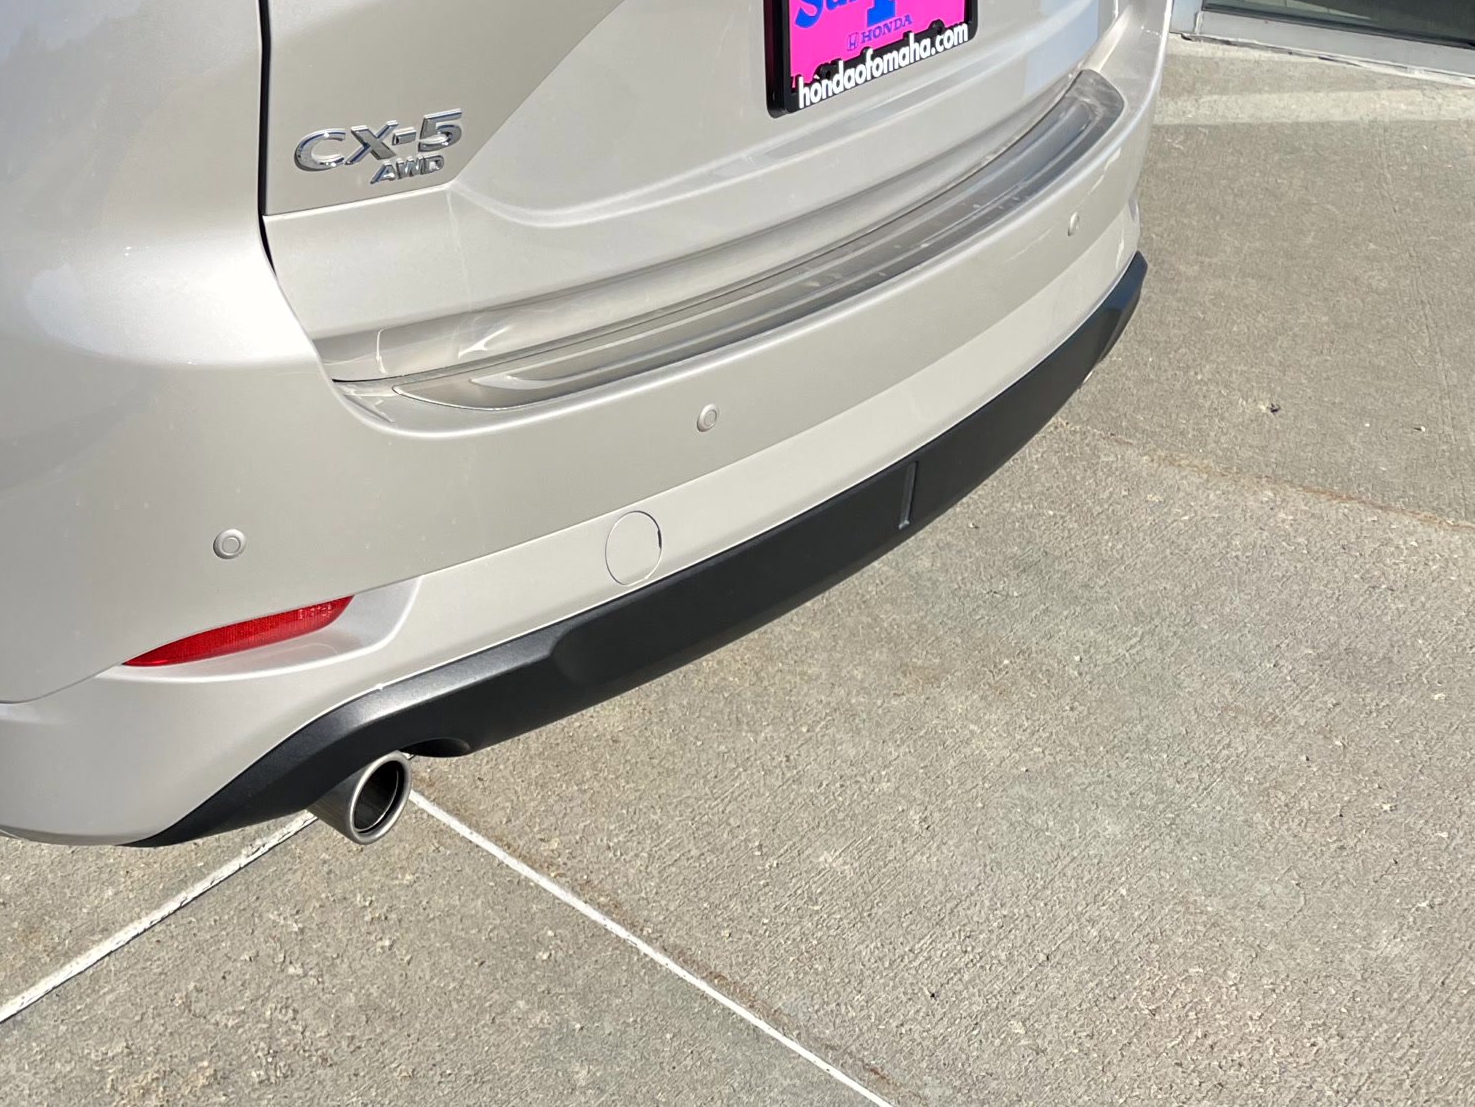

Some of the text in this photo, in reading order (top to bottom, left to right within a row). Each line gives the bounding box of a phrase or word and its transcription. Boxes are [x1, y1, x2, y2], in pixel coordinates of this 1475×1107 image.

[861, 14, 914, 44] HONDA
[797, 23, 969, 109] hondaofomaha.com
[294, 108, 463, 172] CX-5
[370, 154, 445, 184] AWD
